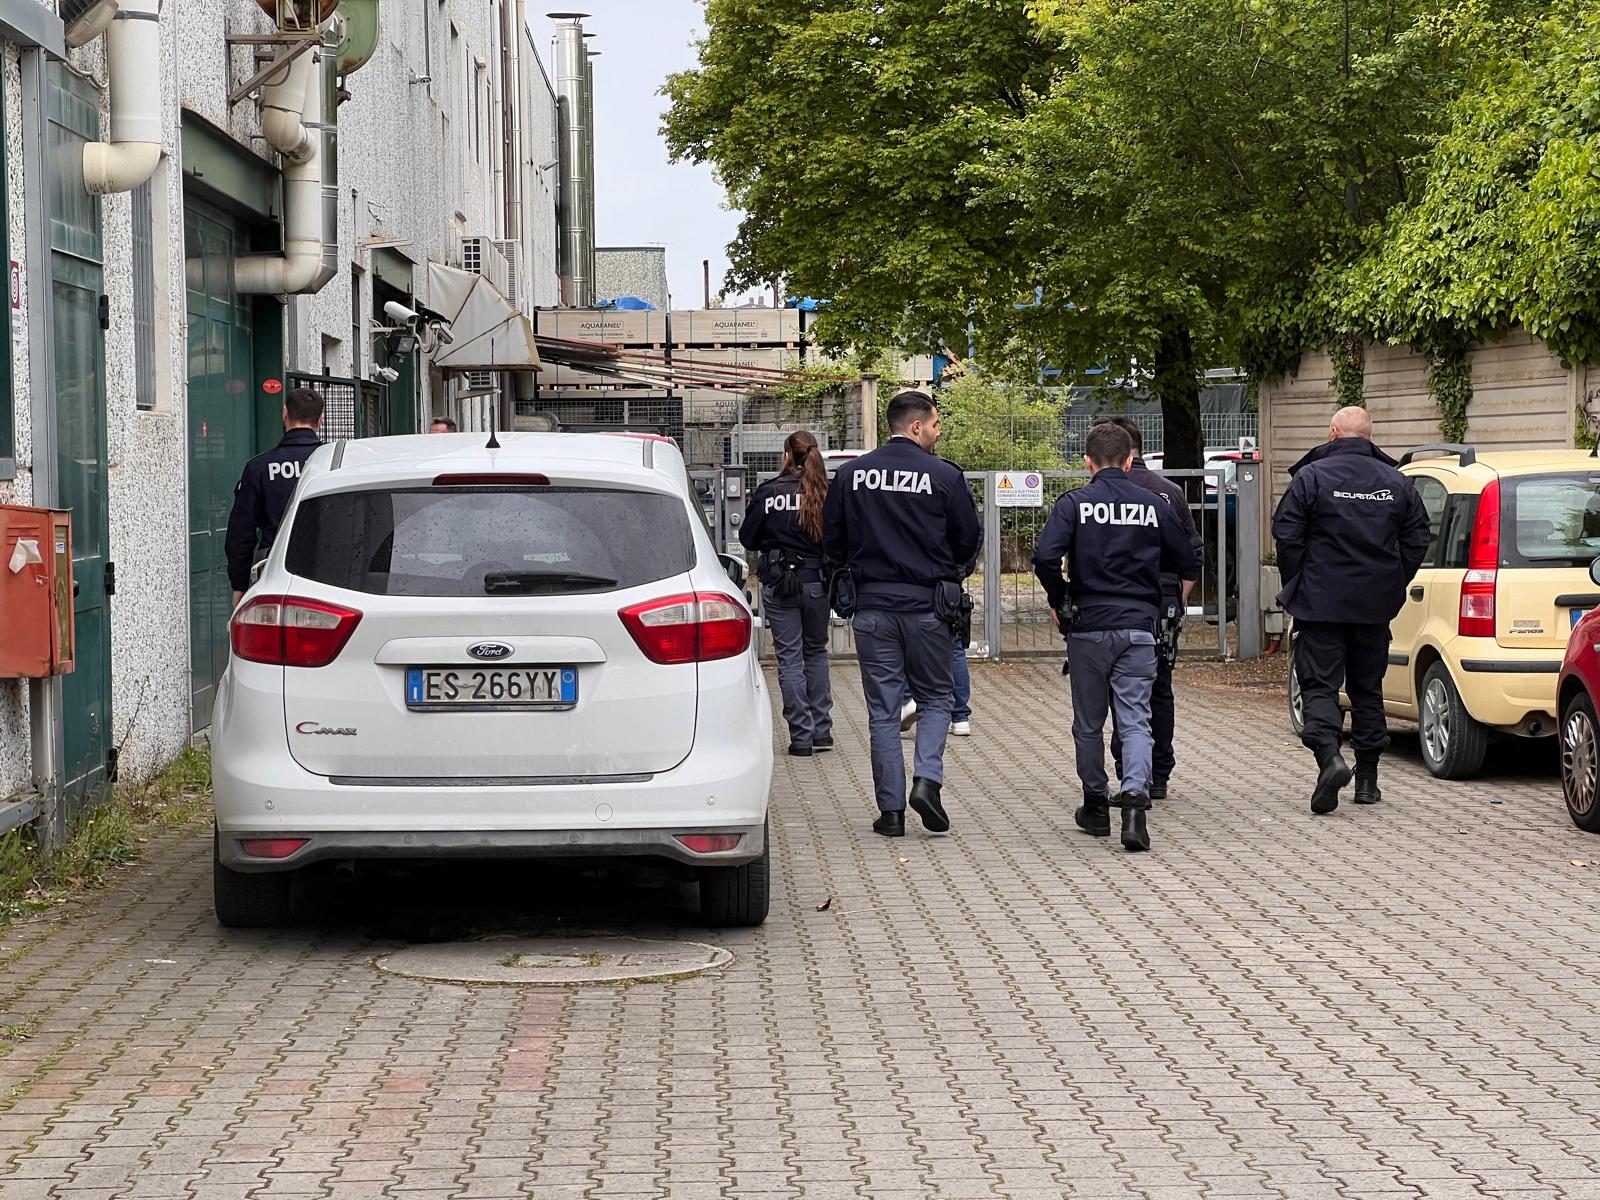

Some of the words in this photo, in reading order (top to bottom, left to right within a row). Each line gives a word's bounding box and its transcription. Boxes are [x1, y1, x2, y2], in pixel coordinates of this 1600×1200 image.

[268, 461, 301, 481] POL
[853, 469, 932, 494] POLIZIA
[764, 493, 801, 514] POLI
[1080, 502, 1159, 528] POLIZIA
[476, 644, 504, 656] Ford
[426, 672, 459, 700] ES
[472, 671, 557, 700] 266YY
